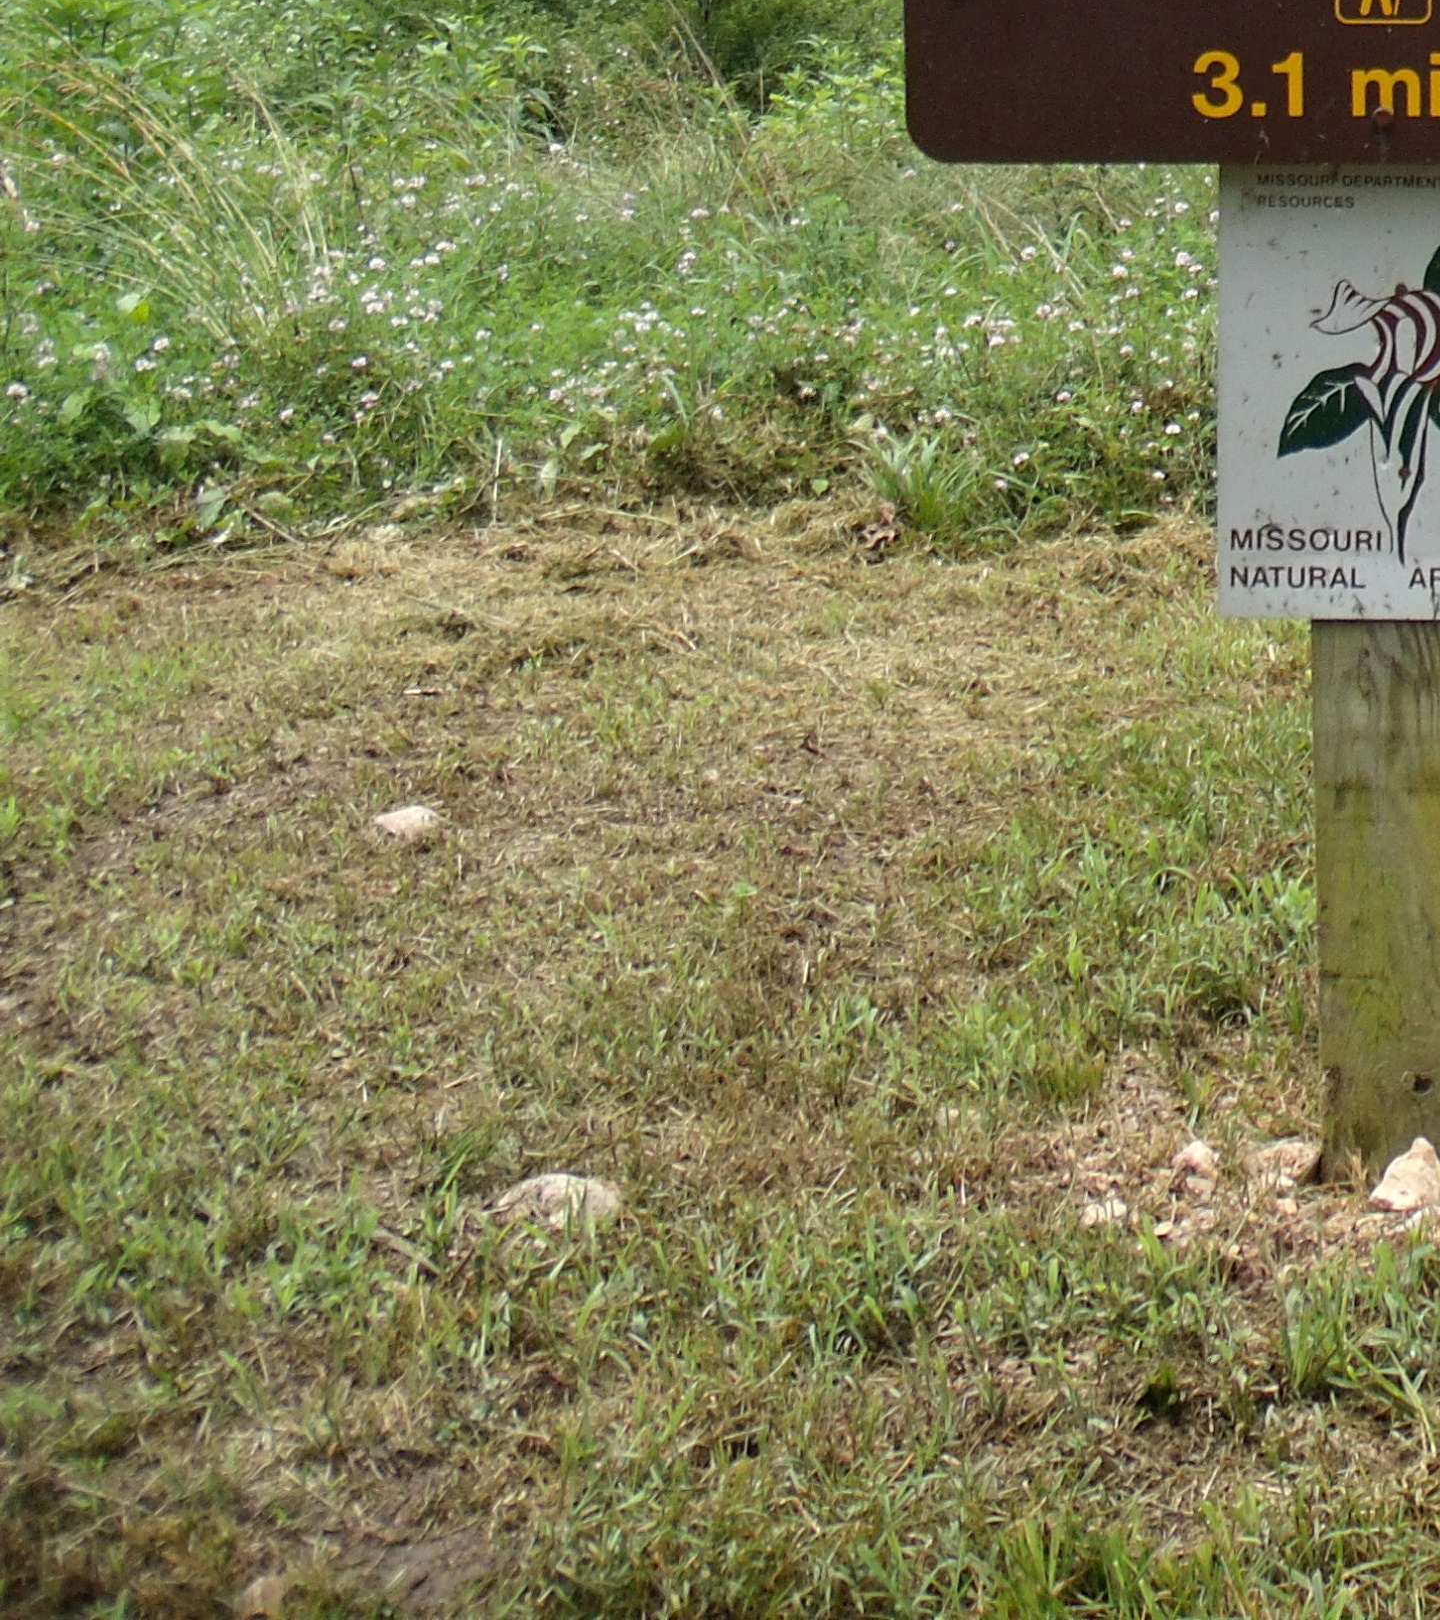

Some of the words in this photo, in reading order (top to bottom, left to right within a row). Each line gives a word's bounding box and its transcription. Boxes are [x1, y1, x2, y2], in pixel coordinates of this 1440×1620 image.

[1191, 51, 1307, 120] 3.1
[1256, 174, 1336, 188] MISSOURI
[1257, 195, 1355, 209] RESOURCES
[1229, 527, 1382, 552] MISSOURI
[1229, 565, 1366, 589] NATURAL
